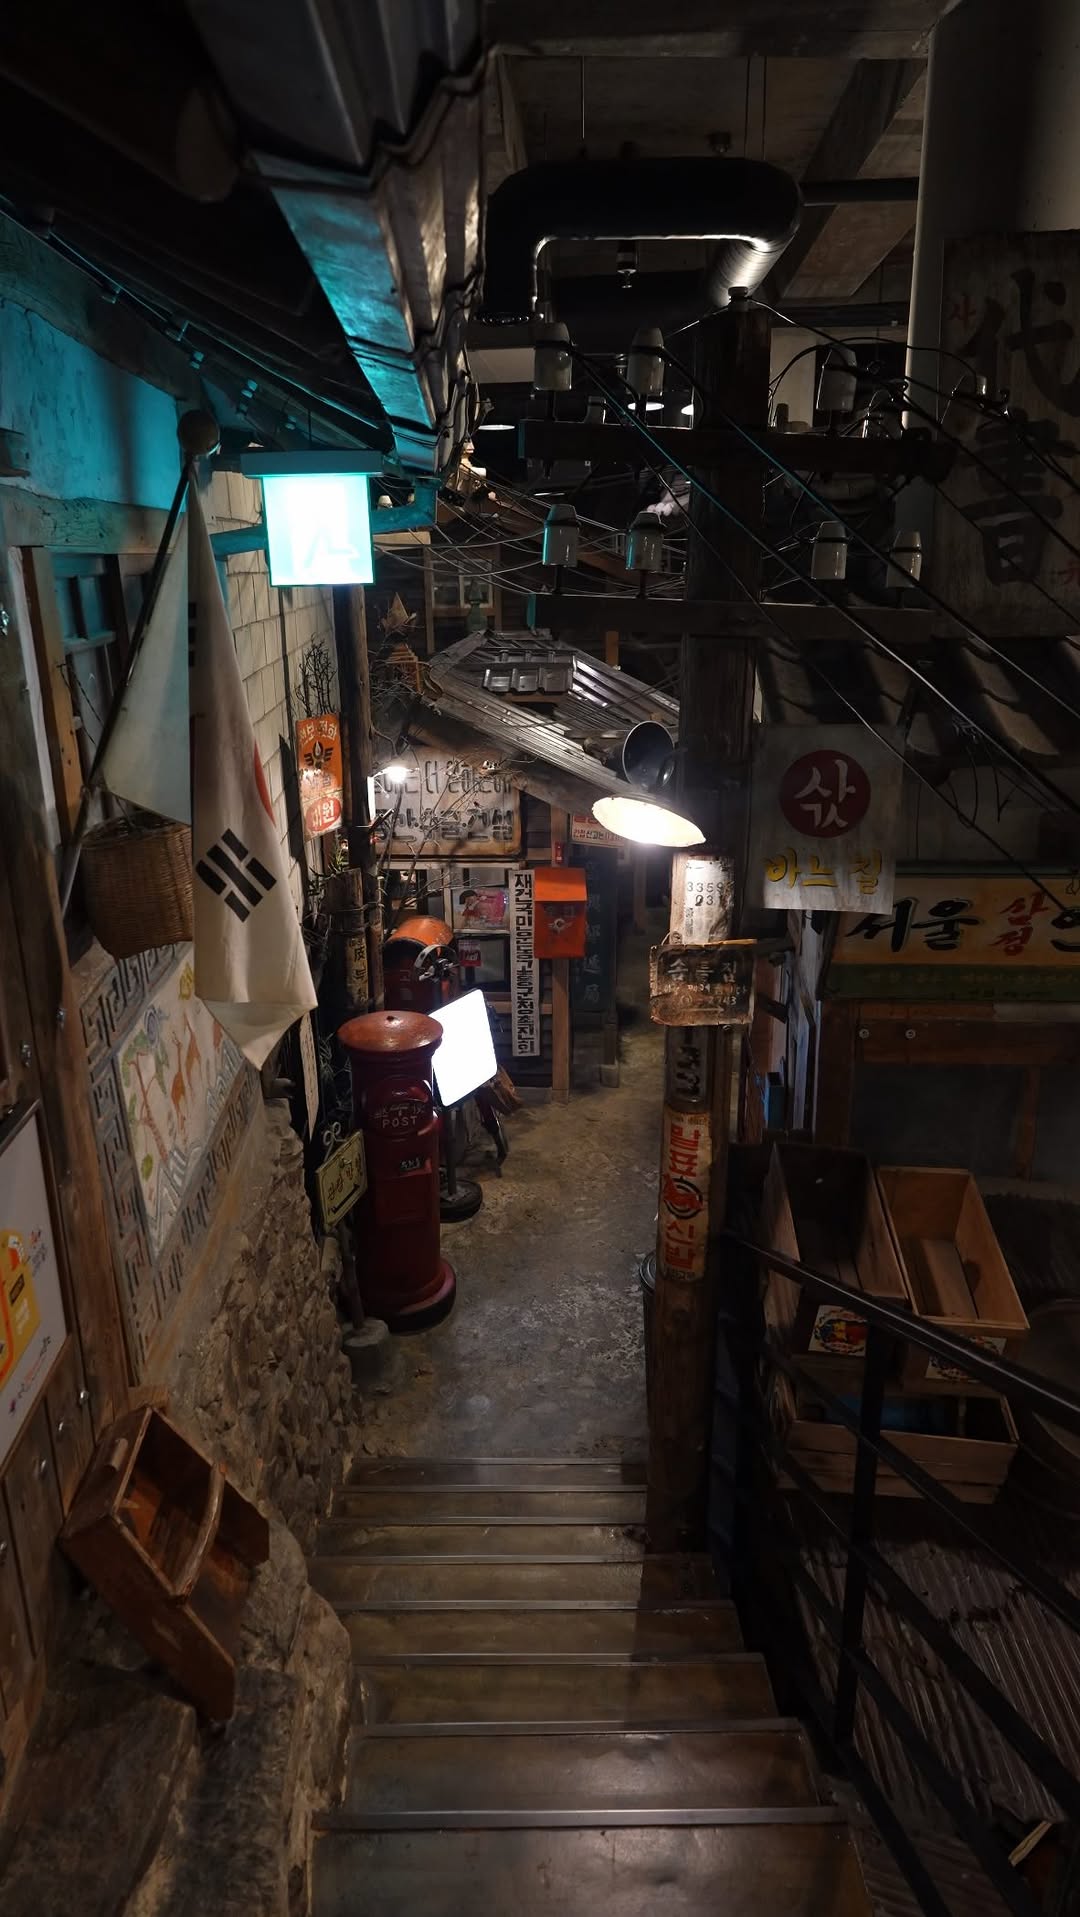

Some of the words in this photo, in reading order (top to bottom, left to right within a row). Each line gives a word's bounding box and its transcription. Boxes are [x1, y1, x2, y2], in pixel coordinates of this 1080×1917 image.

[793, 758, 857, 829] 삯
[843, 897, 982, 952] 서울
[381, 1115, 418, 1129] POST
